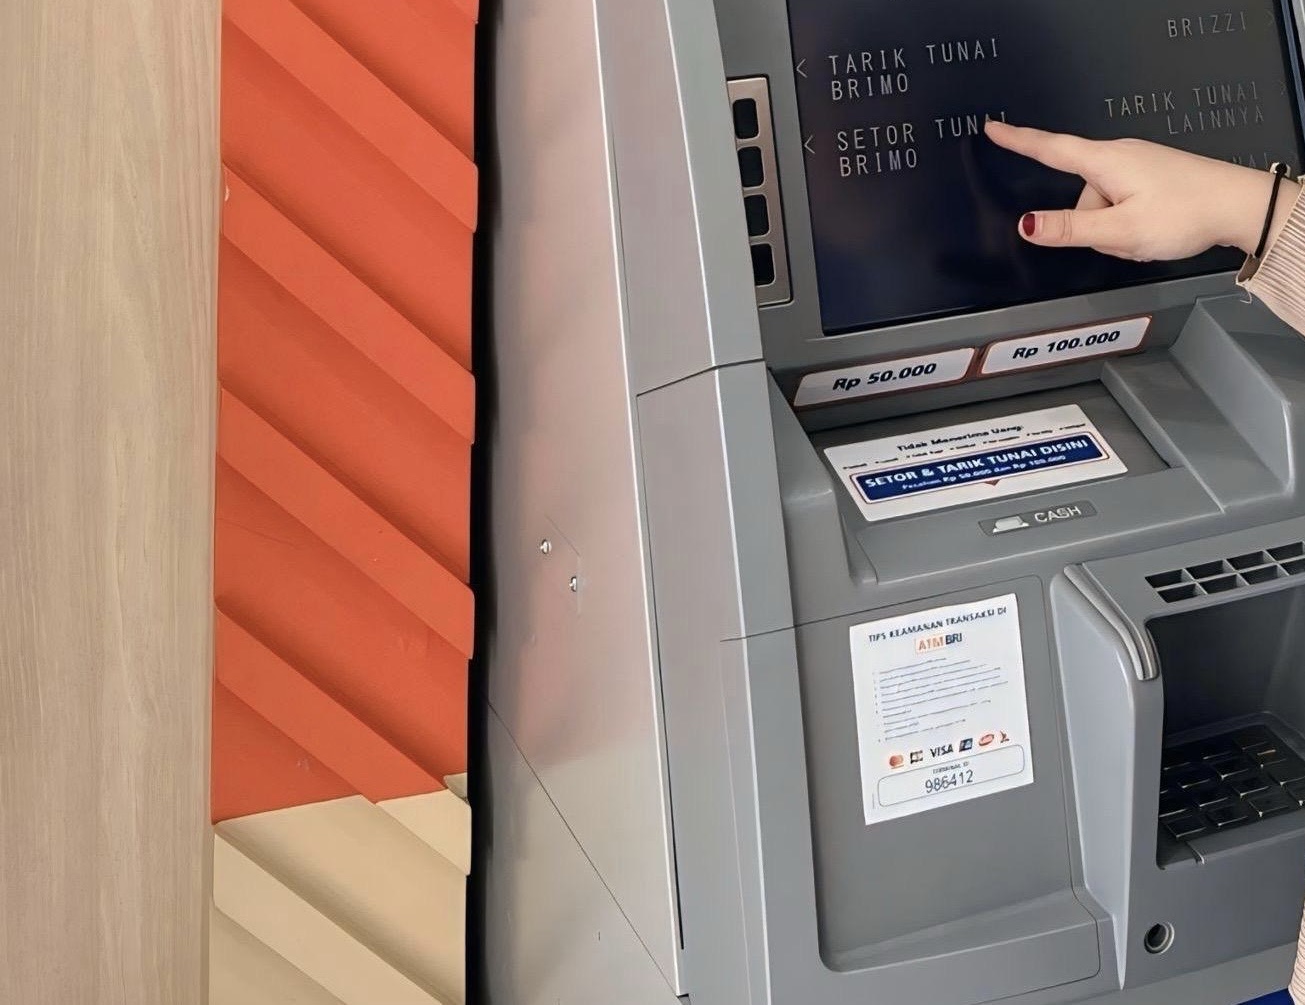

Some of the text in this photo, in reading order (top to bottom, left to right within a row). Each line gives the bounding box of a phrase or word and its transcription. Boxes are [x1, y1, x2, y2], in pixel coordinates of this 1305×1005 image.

[1166, 10, 1247, 39] BRIZZI
[828, 37, 1000, 77] TARIK TUNAI
[830, 72, 910, 102] BRIMO
[1104, 80, 1259, 120] TARIK TUNAI
[1166, 104, 1265, 137] LAINNYA
[837, 122, 916, 153] SETOR
[840, 148, 919, 178] BRIMO
[1012, 330, 1121, 361] Rp 100.000
[832, 362, 937, 392] Rp 50.000
[865, 470, 919, 488] SETOR
[921, 468, 935, 478] &
[937, 458, 985, 474] TARIK
[986, 448, 1038, 465] TUNAI
[1039, 439, 1089, 455] DISINI
[1034, 504, 1082, 524] CASH
[868, 632, 887, 643] TIPS
[930, 743, 954, 758] VISA
